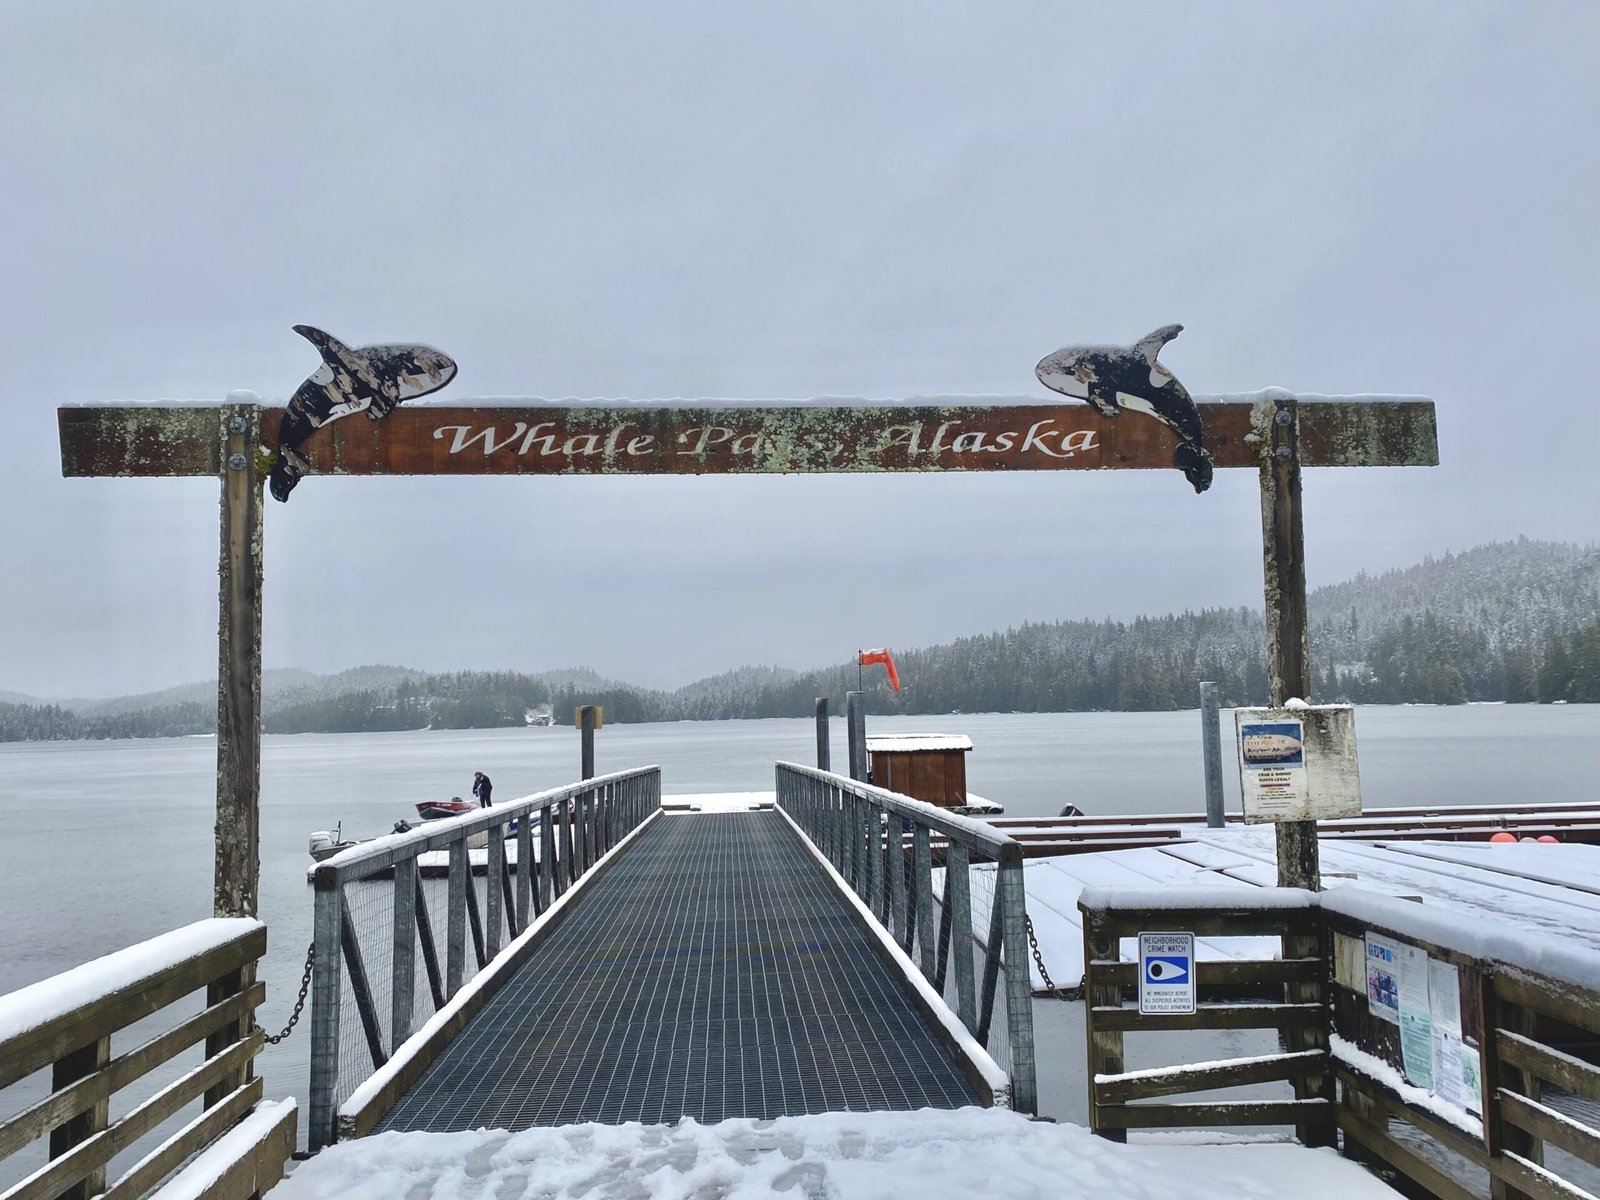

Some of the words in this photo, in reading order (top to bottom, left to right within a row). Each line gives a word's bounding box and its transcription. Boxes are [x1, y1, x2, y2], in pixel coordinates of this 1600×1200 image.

[433, 422, 655, 456] Whale
[870, 419, 1100, 457] Alaska
[1143, 936, 1189, 945] NEIGHBORHOOD
